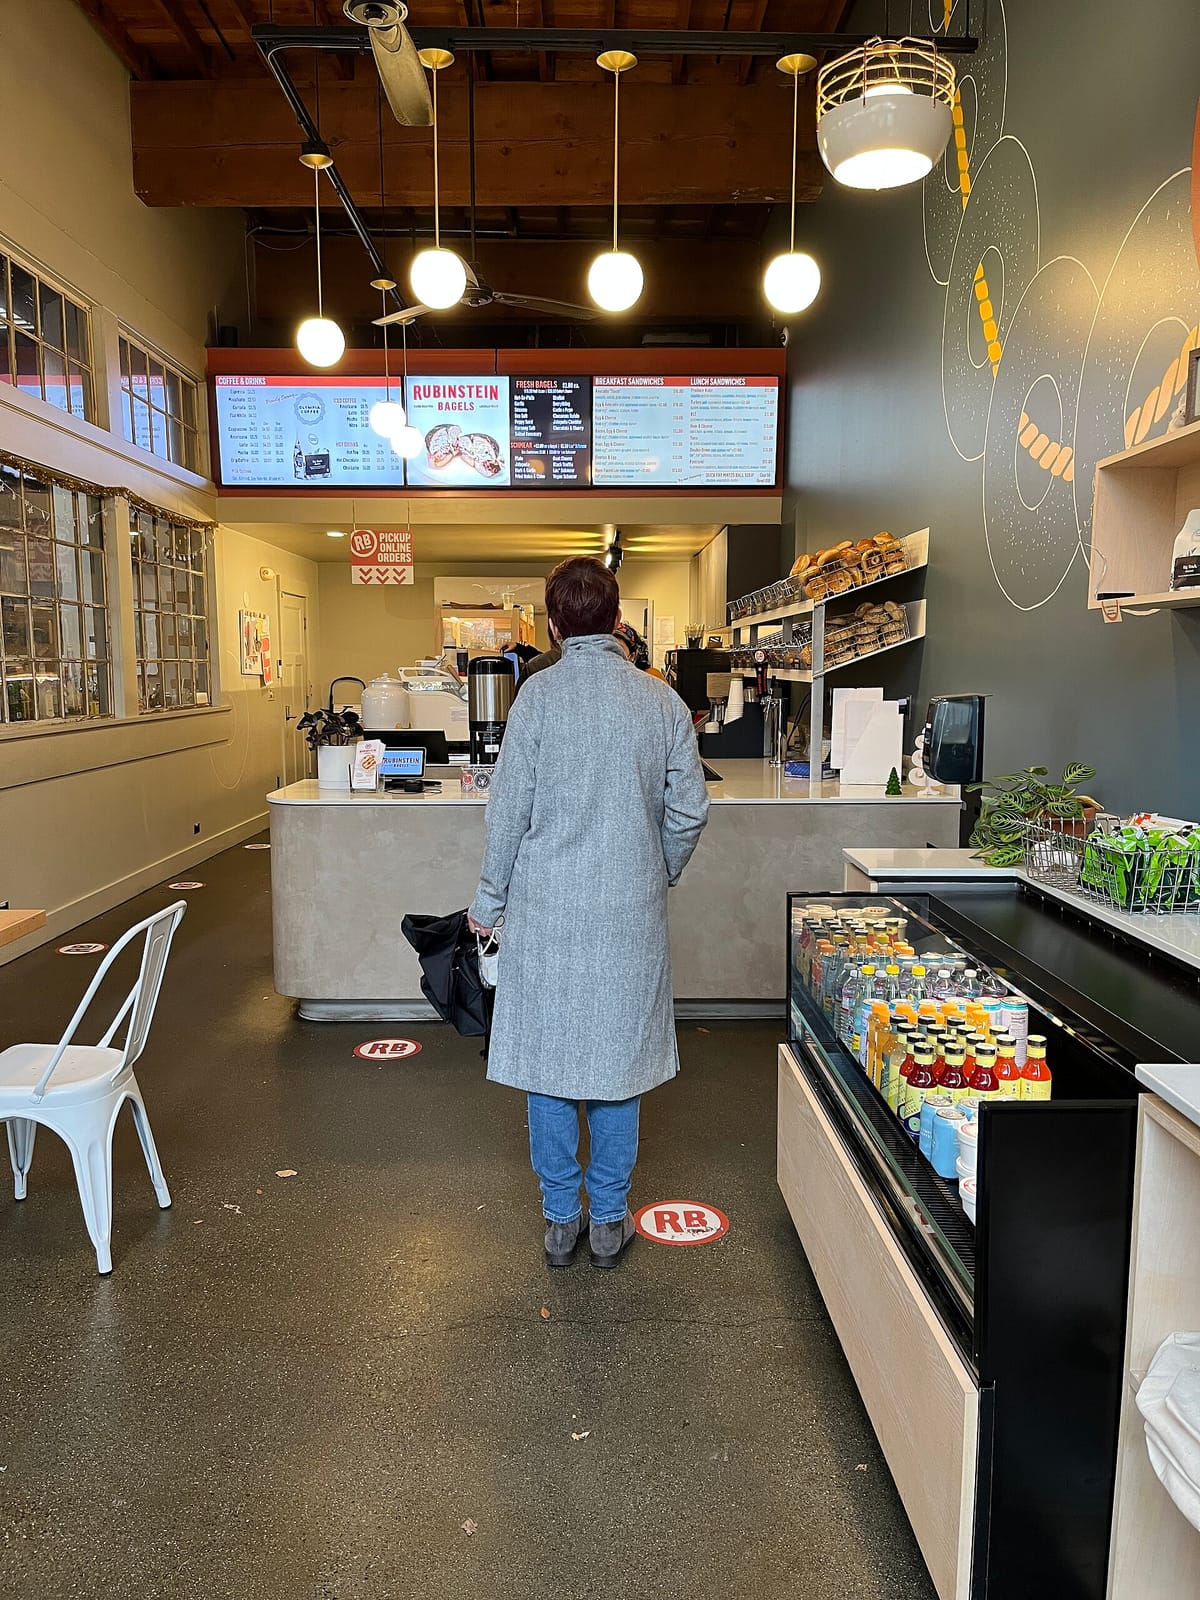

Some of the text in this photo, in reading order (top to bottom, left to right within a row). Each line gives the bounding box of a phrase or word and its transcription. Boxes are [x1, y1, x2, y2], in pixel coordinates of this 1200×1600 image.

[710, 378, 746, 386] SANDWICHES
[414, 385, 498, 400] RUBINSTEIN
[438, 402, 474, 411] BAGELS
[354, 533, 372, 551] RB
[379, 532, 411, 543] PICKUP
[380, 543, 411, 552] ONLINE
[377, 553, 412, 562] ORDERS
[368, 1043, 408, 1054] RB
[654, 1211, 708, 1233] RB
